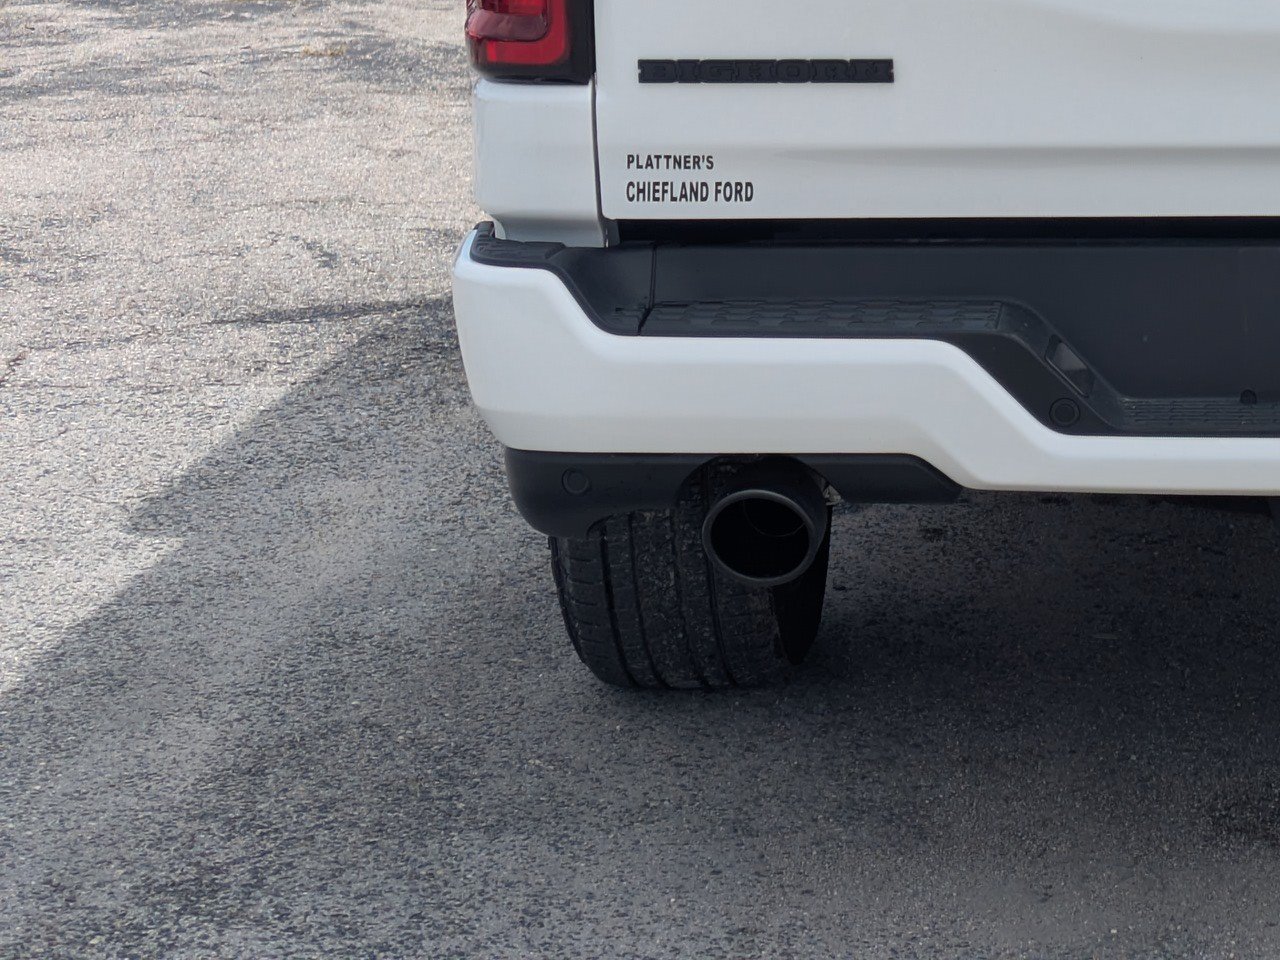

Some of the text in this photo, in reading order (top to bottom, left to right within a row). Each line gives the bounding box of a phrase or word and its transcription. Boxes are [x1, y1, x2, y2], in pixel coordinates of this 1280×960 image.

[627, 154, 715, 170] PLATTNER'S
[626, 181, 754, 202] CHIEFLAND FORD
